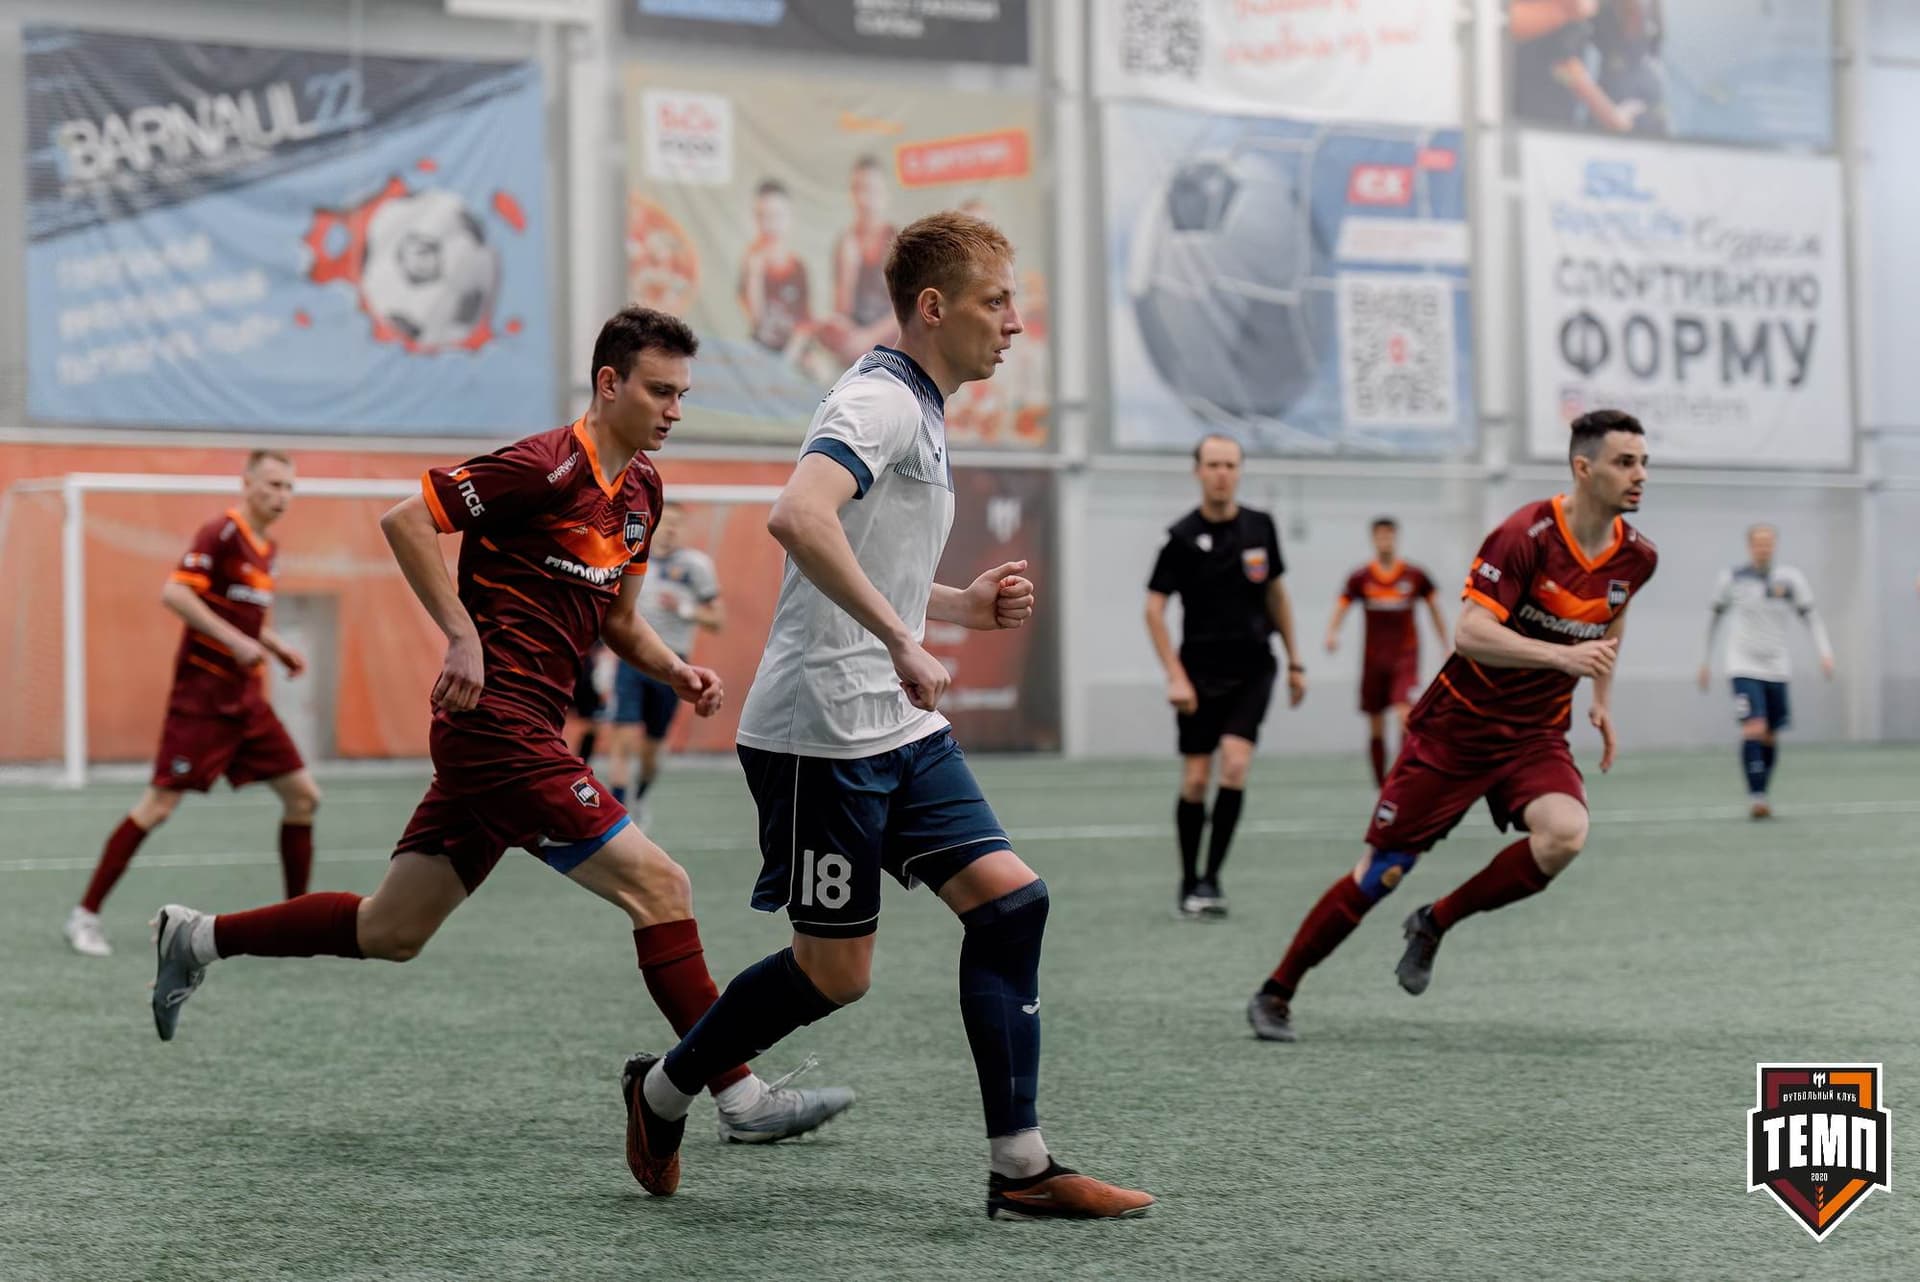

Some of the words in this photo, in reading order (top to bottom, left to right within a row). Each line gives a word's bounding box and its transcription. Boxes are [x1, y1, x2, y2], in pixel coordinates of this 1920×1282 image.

[1557, 255, 1822, 309] СПОРТИВНУЮ
[1560, 310, 1817, 388] ФОРМУ
[458, 480, 486, 518] ПСБ
[802, 849, 852, 909] 18
